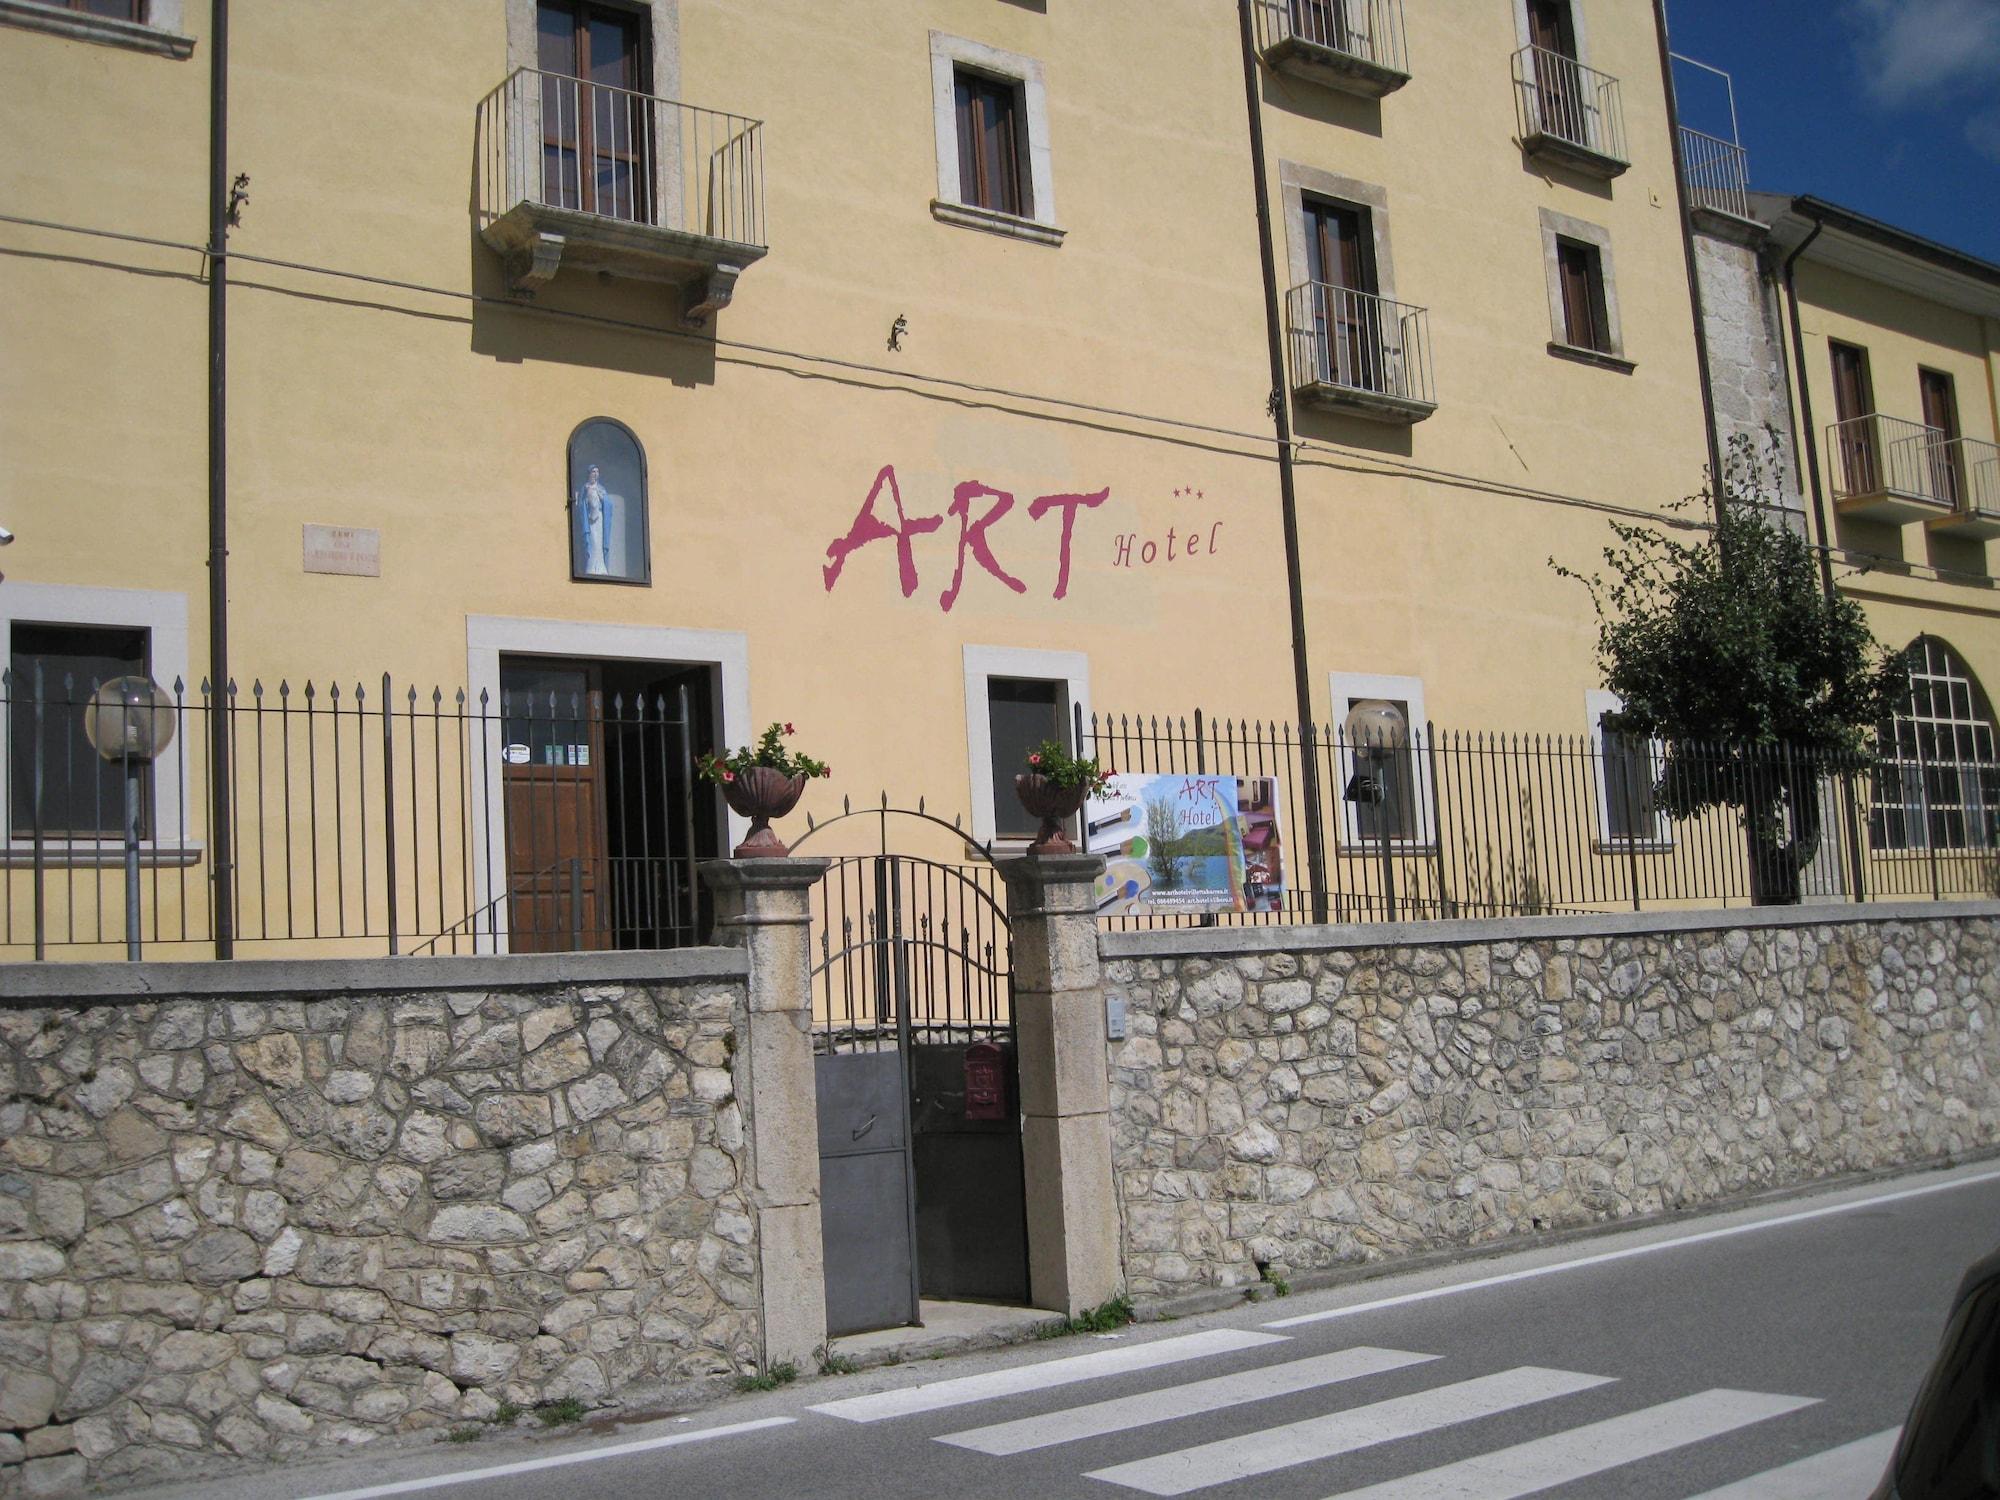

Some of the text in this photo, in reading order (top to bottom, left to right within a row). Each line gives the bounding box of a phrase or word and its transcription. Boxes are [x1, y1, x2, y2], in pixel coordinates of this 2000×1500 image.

[822, 464, 1223, 613] ART Hotel
[1178, 777, 1220, 805] ART
[1178, 808, 1216, 827] Hotel
